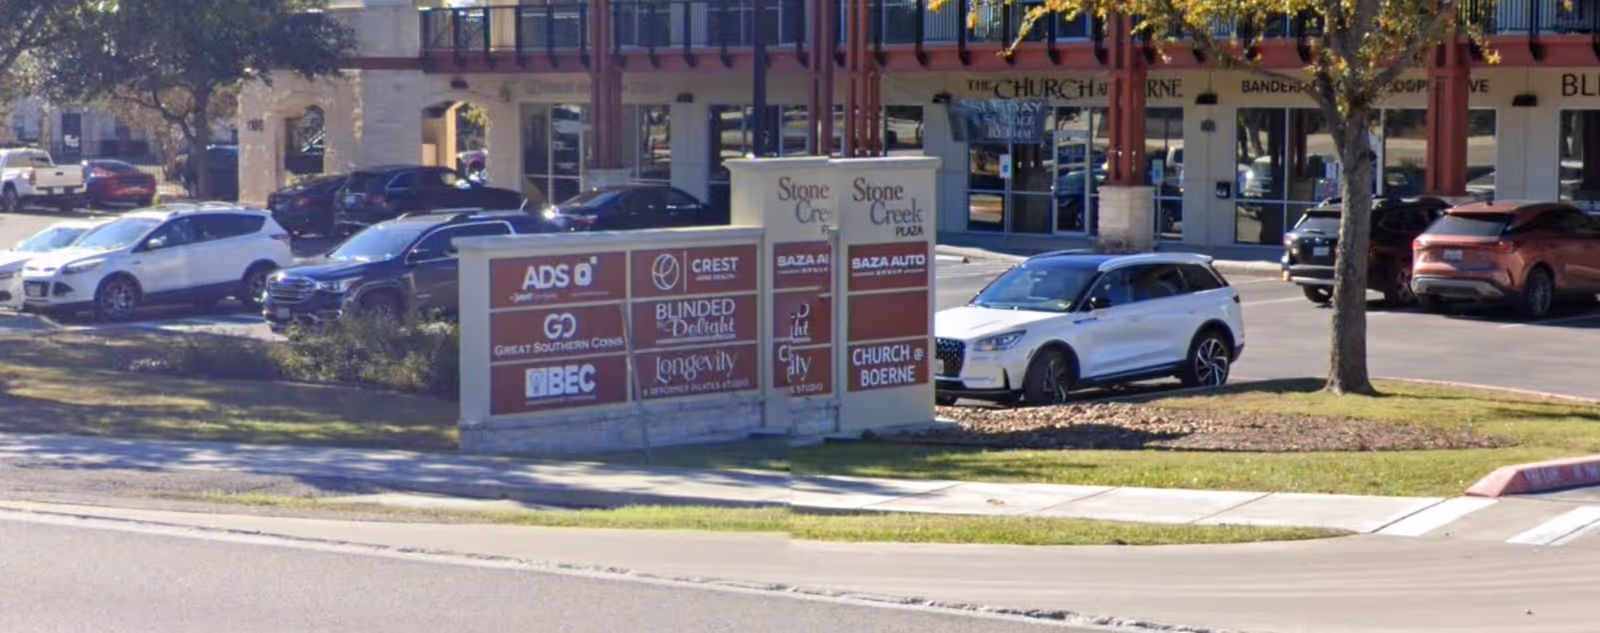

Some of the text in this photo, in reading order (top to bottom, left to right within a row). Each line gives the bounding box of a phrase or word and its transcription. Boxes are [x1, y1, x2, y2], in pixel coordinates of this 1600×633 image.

[994, 76, 1094, 99] CHURCH
[778, 176, 829, 201] Stone
[853, 176, 904, 202] Stone
[795, 199, 830, 223] Cre
[870, 197, 923, 225] Creek
[895, 226, 923, 236] PLAZA
[692, 257, 739, 273] CREST
[777, 254, 815, 266] SAZA
[852, 254, 926, 269] SAZA AUTO
[522, 264, 570, 290] ADS
[656, 298, 736, 320] BLINDED
[664, 315, 735, 337] Delight
[494, 344, 532, 356] GREAT
[533, 339, 590, 353] SOUTHERN
[852, 345, 910, 366] CHURCH
[548, 363, 596, 396] BEC
[861, 365, 915, 387] BOERNE
